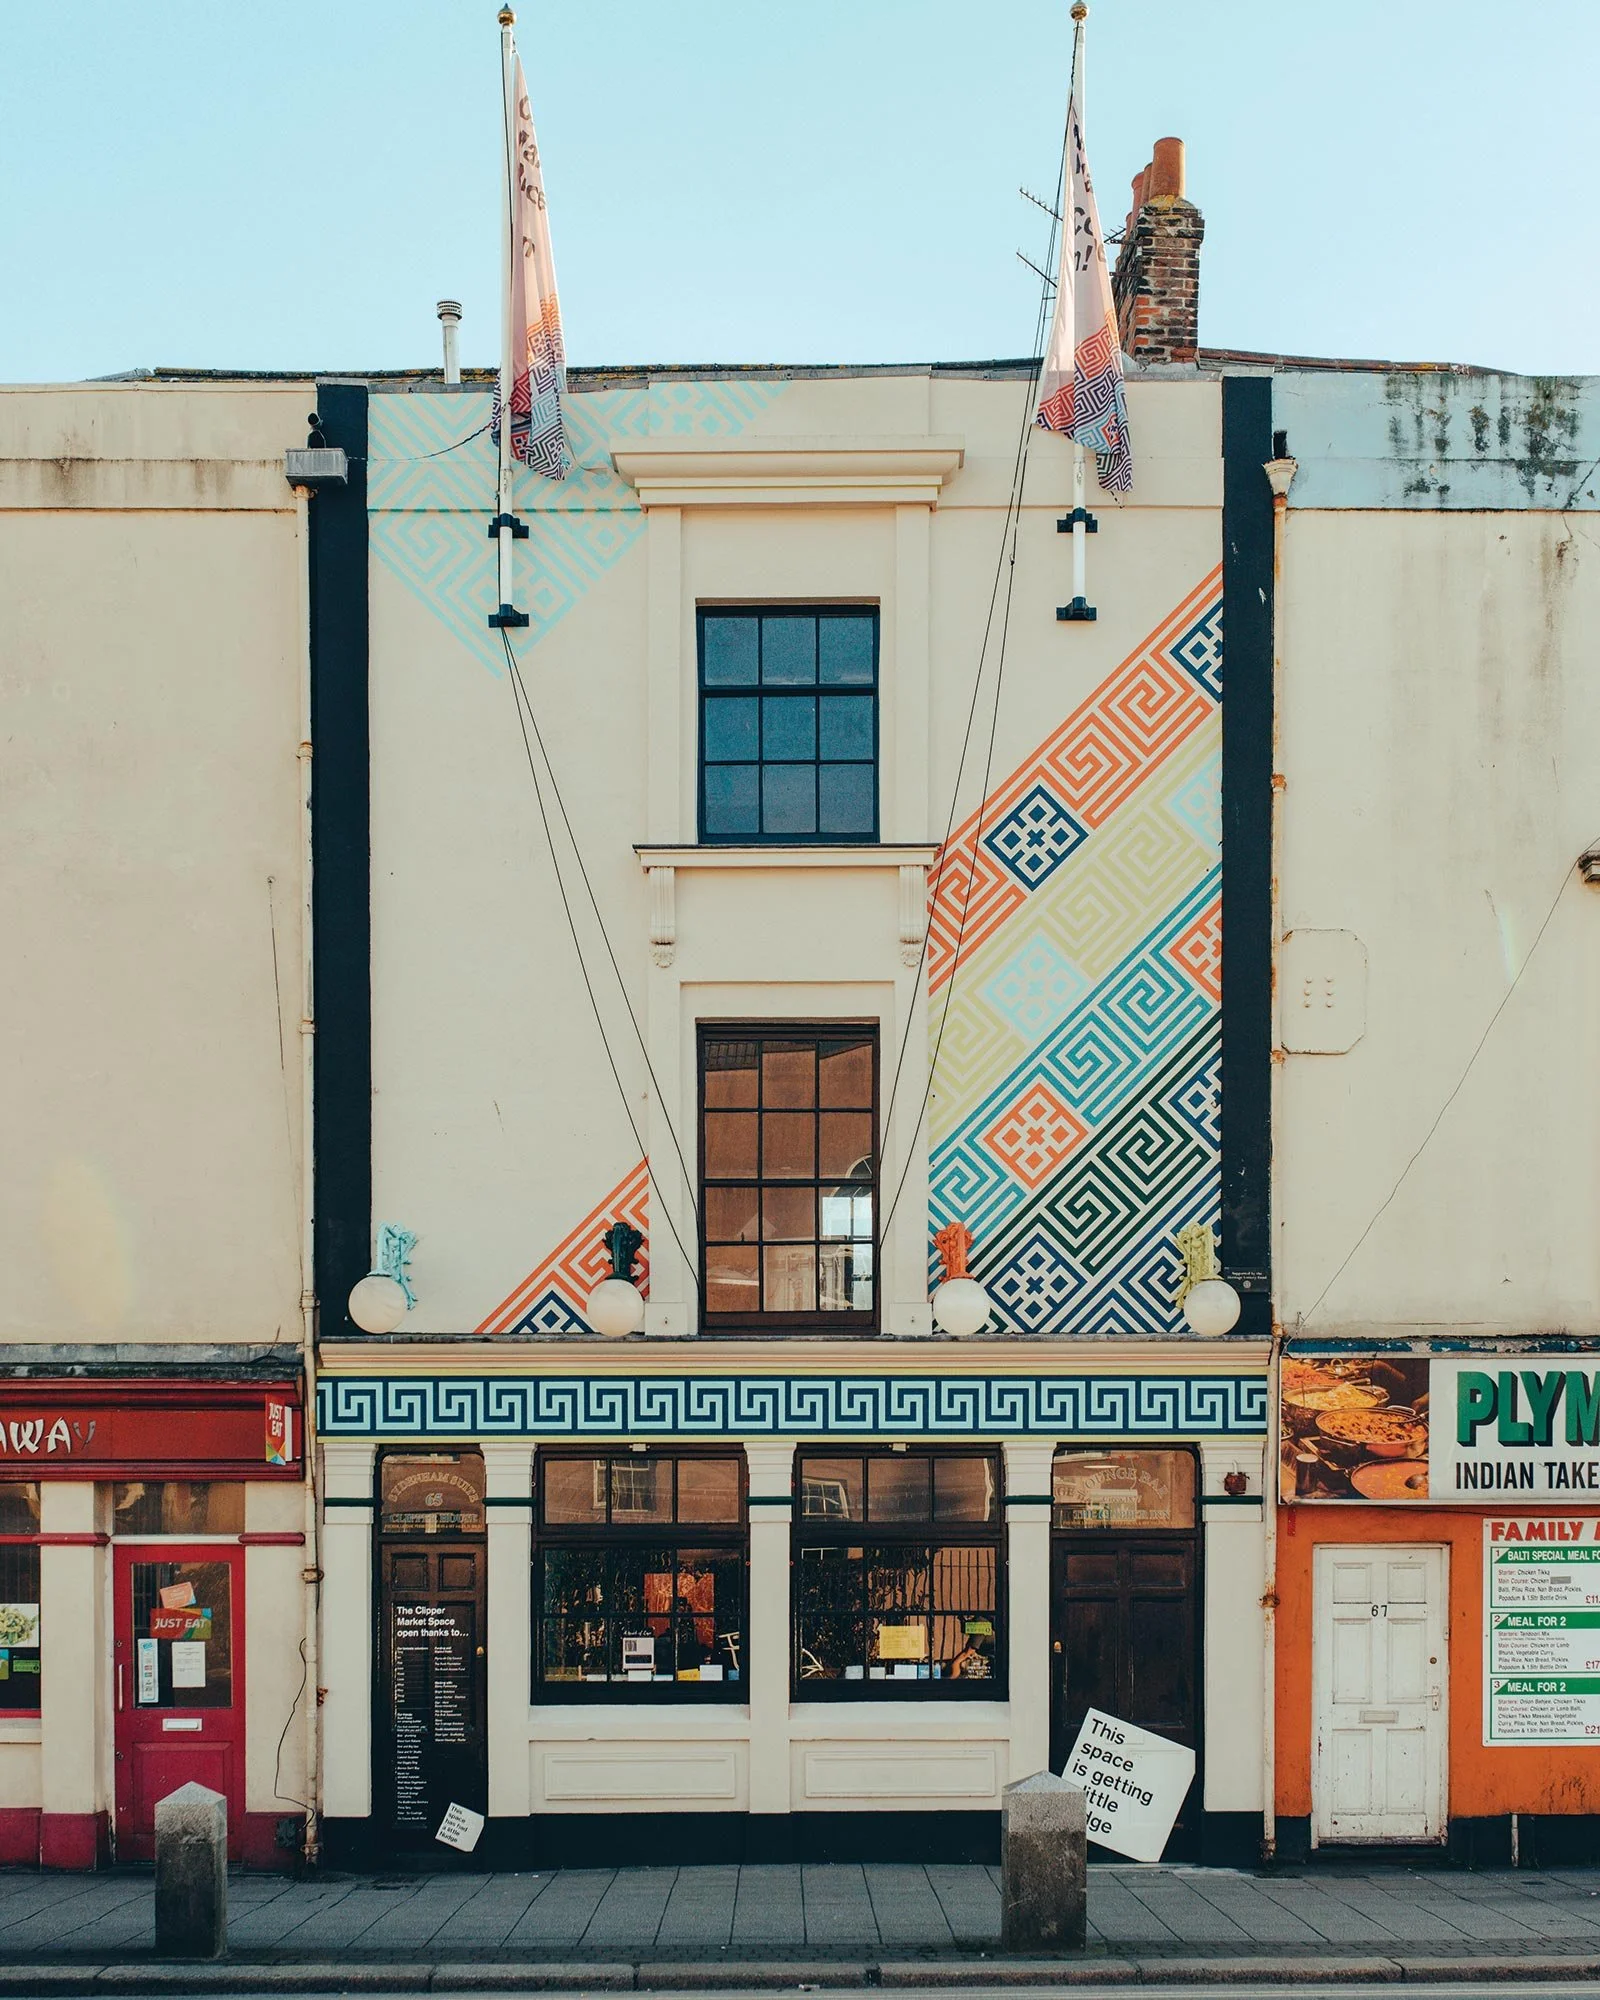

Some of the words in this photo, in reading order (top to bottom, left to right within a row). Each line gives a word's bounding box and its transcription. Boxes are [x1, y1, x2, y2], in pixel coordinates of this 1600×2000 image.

[269, 1402, 282, 1420] JUST
[1457, 1371, 1600, 1446] PLYM
[0, 1416, 96, 1454] WAY
[272, 1420, 282, 1437] EAT
[1456, 1462, 1534, 1489] INDIAN
[1544, 1462, 1600, 1489] TAKE
[425, 1492, 443, 1506] 65
[1491, 1522, 1584, 1541] FAMILY
[1508, 1551, 1529, 1560] BALTI
[1532, 1551, 1565, 1560] SPECIAL
[1568, 1551, 1590, 1560] MEAL
[397, 1606, 413, 1614] The
[415, 1606, 445, 1616] Clipper
[1372, 1605, 1387, 1617] 67
[155, 1618, 182, 1629] JUST
[185, 1618, 206, 1628] EAT
[397, 1618, 426, 1626] Market
[428, 1617, 455, 1627] Space
[1508, 1617, 1535, 1626] MEAL
[1538, 1617, 1557, 1626] FOR
[1560, 1616, 1566, 1626] 2
[397, 1630, 419, 1638] open
[421, 1628, 449, 1637] thanks
[1508, 1682, 1534, 1692] MEAL
[1537, 1682, 1557, 1692] FOR
[1560, 1682, 1566, 1692] 2
[1092, 1718, 1125, 1744] This
[1081, 1742, 1134, 1772] space
[1072, 1758, 1087, 1776] is
[1091, 1771, 1153, 1806] getting
[451, 1806, 462, 1815] This
[448, 1813, 466, 1823] space
